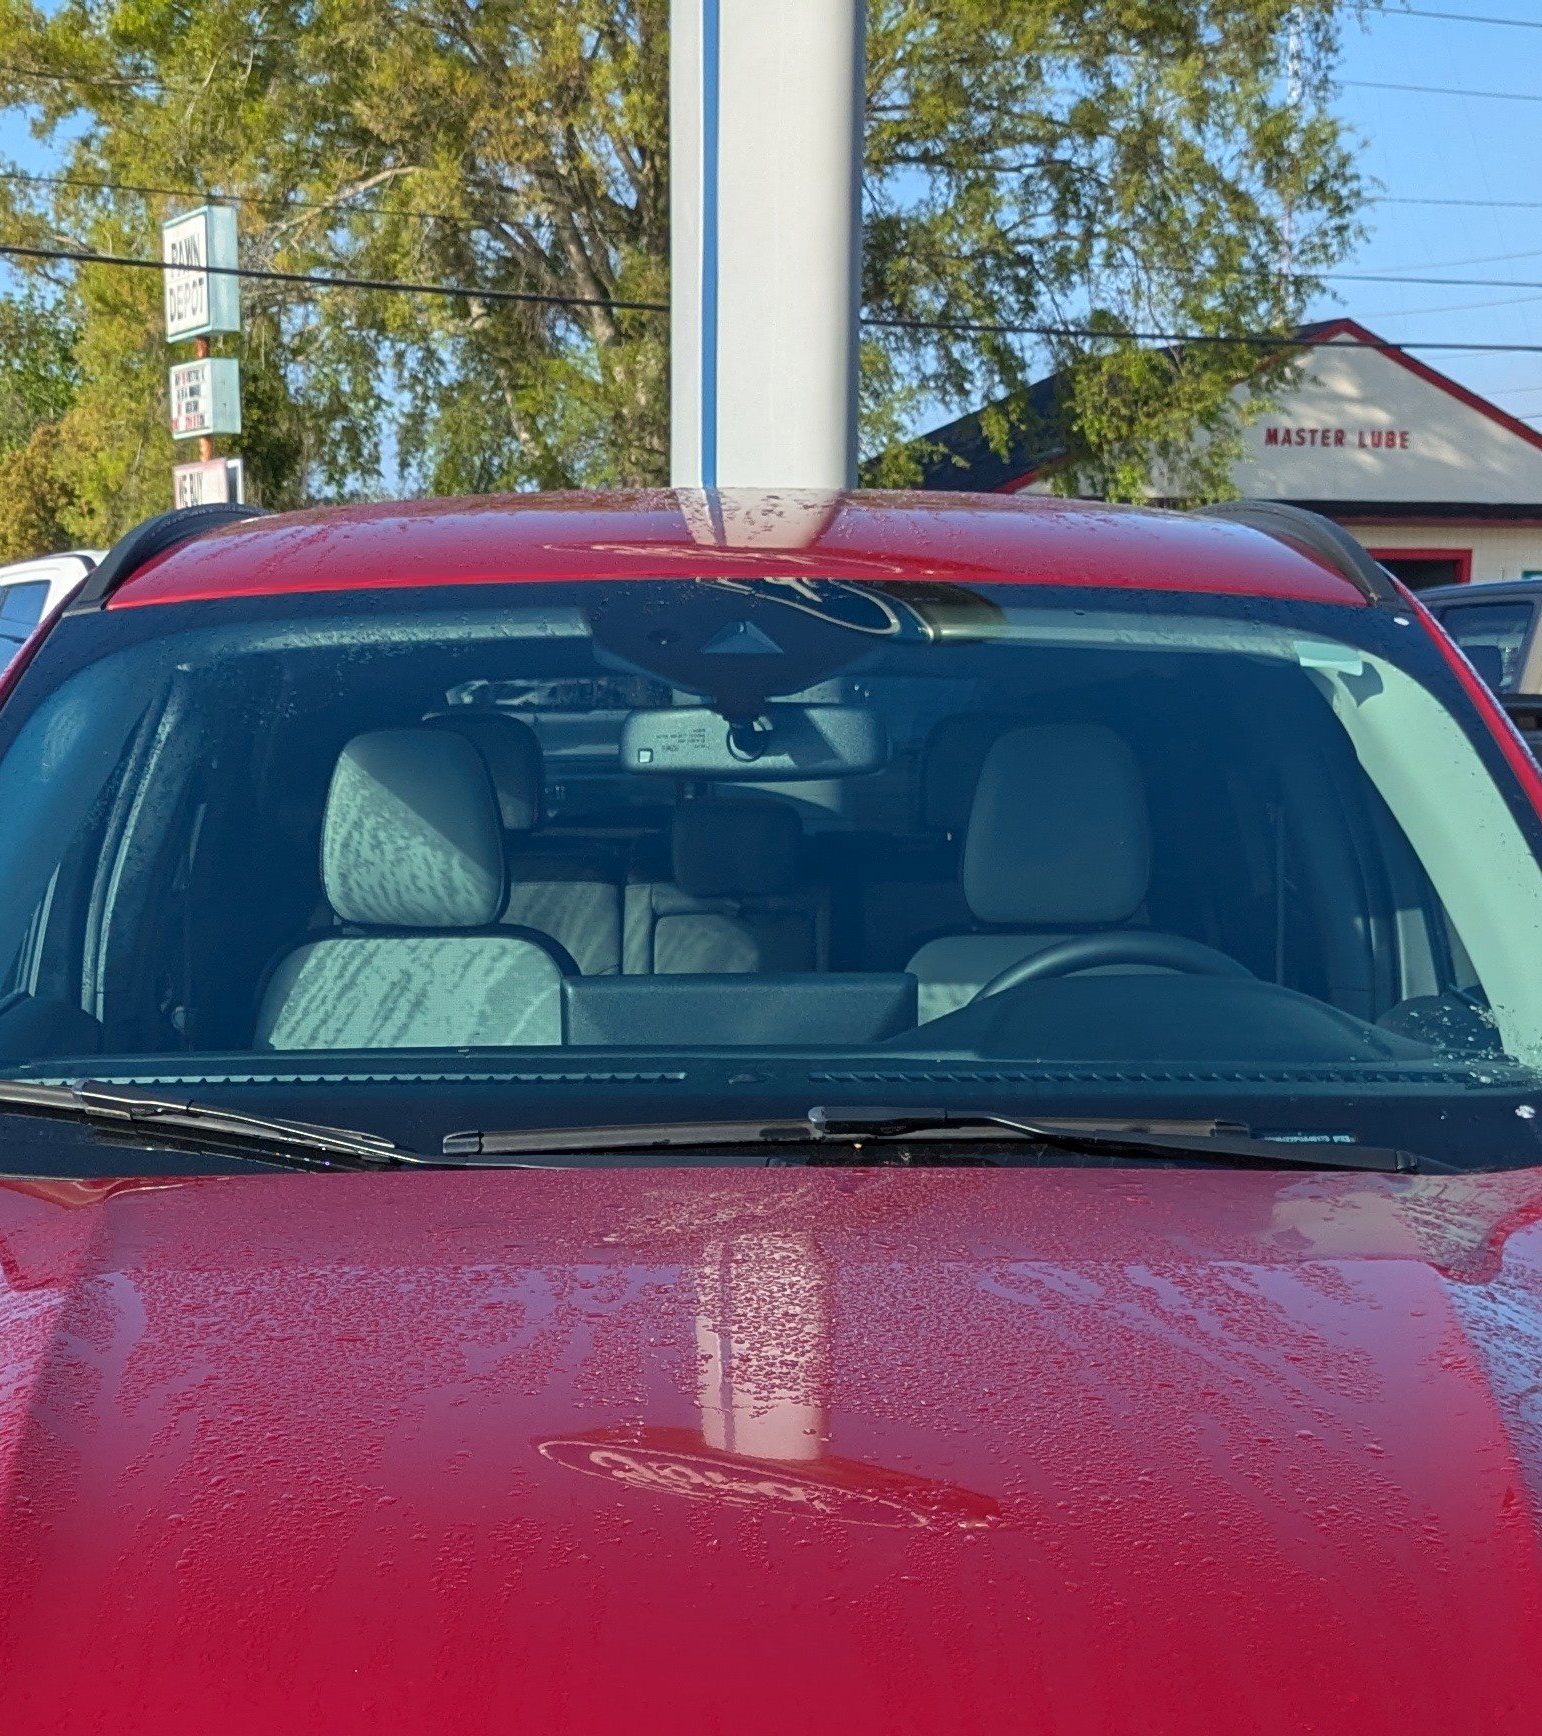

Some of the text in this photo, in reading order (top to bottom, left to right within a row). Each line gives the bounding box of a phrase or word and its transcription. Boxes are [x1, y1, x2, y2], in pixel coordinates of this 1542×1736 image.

[170, 232, 201, 279] PAWN
[169, 276, 204, 322] DEPOT
[1264, 427, 1410, 449] MASTER LUBE
